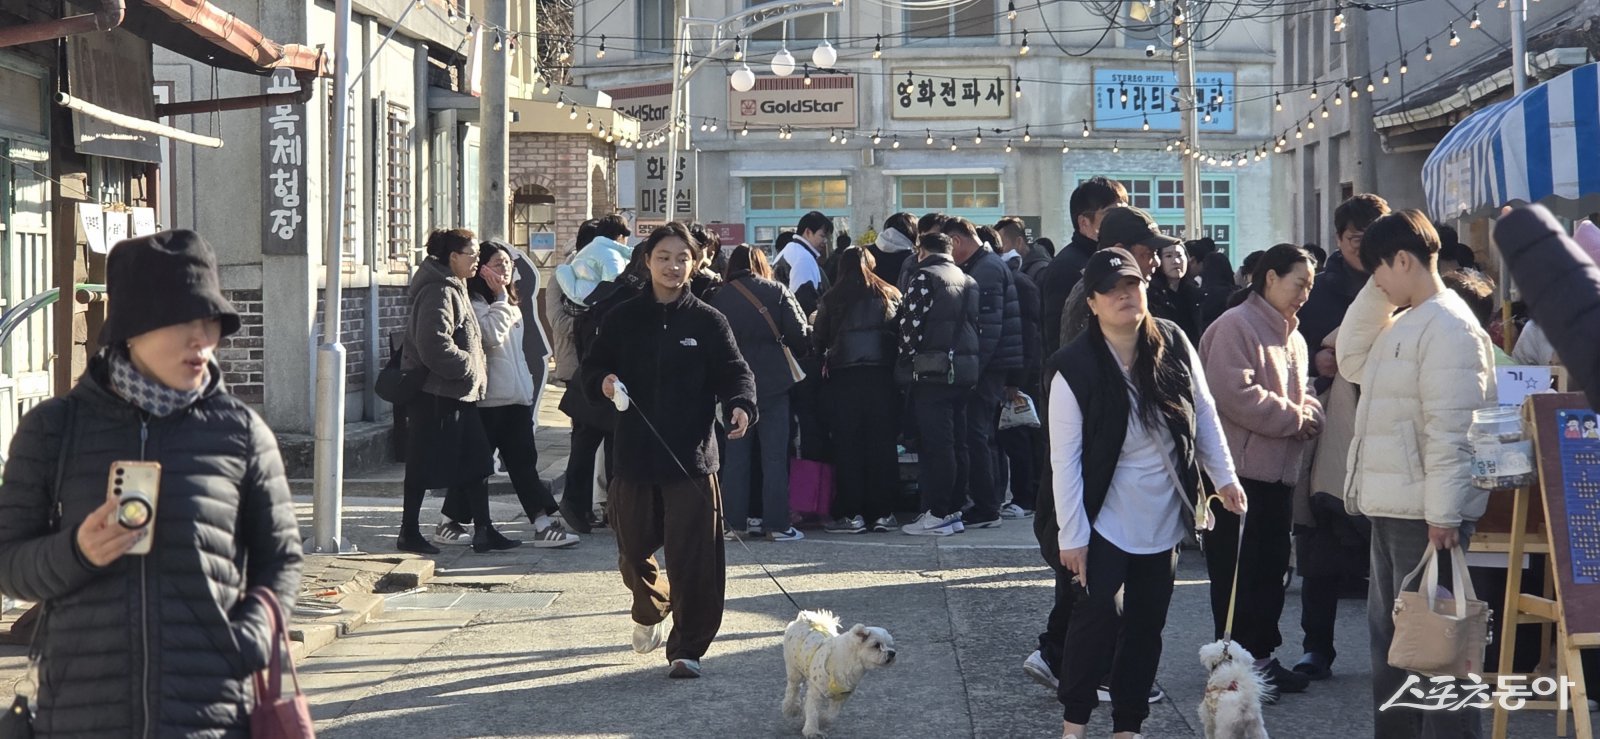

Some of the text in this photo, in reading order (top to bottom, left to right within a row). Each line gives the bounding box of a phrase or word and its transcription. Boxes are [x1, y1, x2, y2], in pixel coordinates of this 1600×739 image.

[1111, 74, 1143, 82] STEREO
[896, 77, 1005, 109] 영화전파사
[760, 99, 844, 114] GoldStar
[641, 188, 691, 213] 미용실
